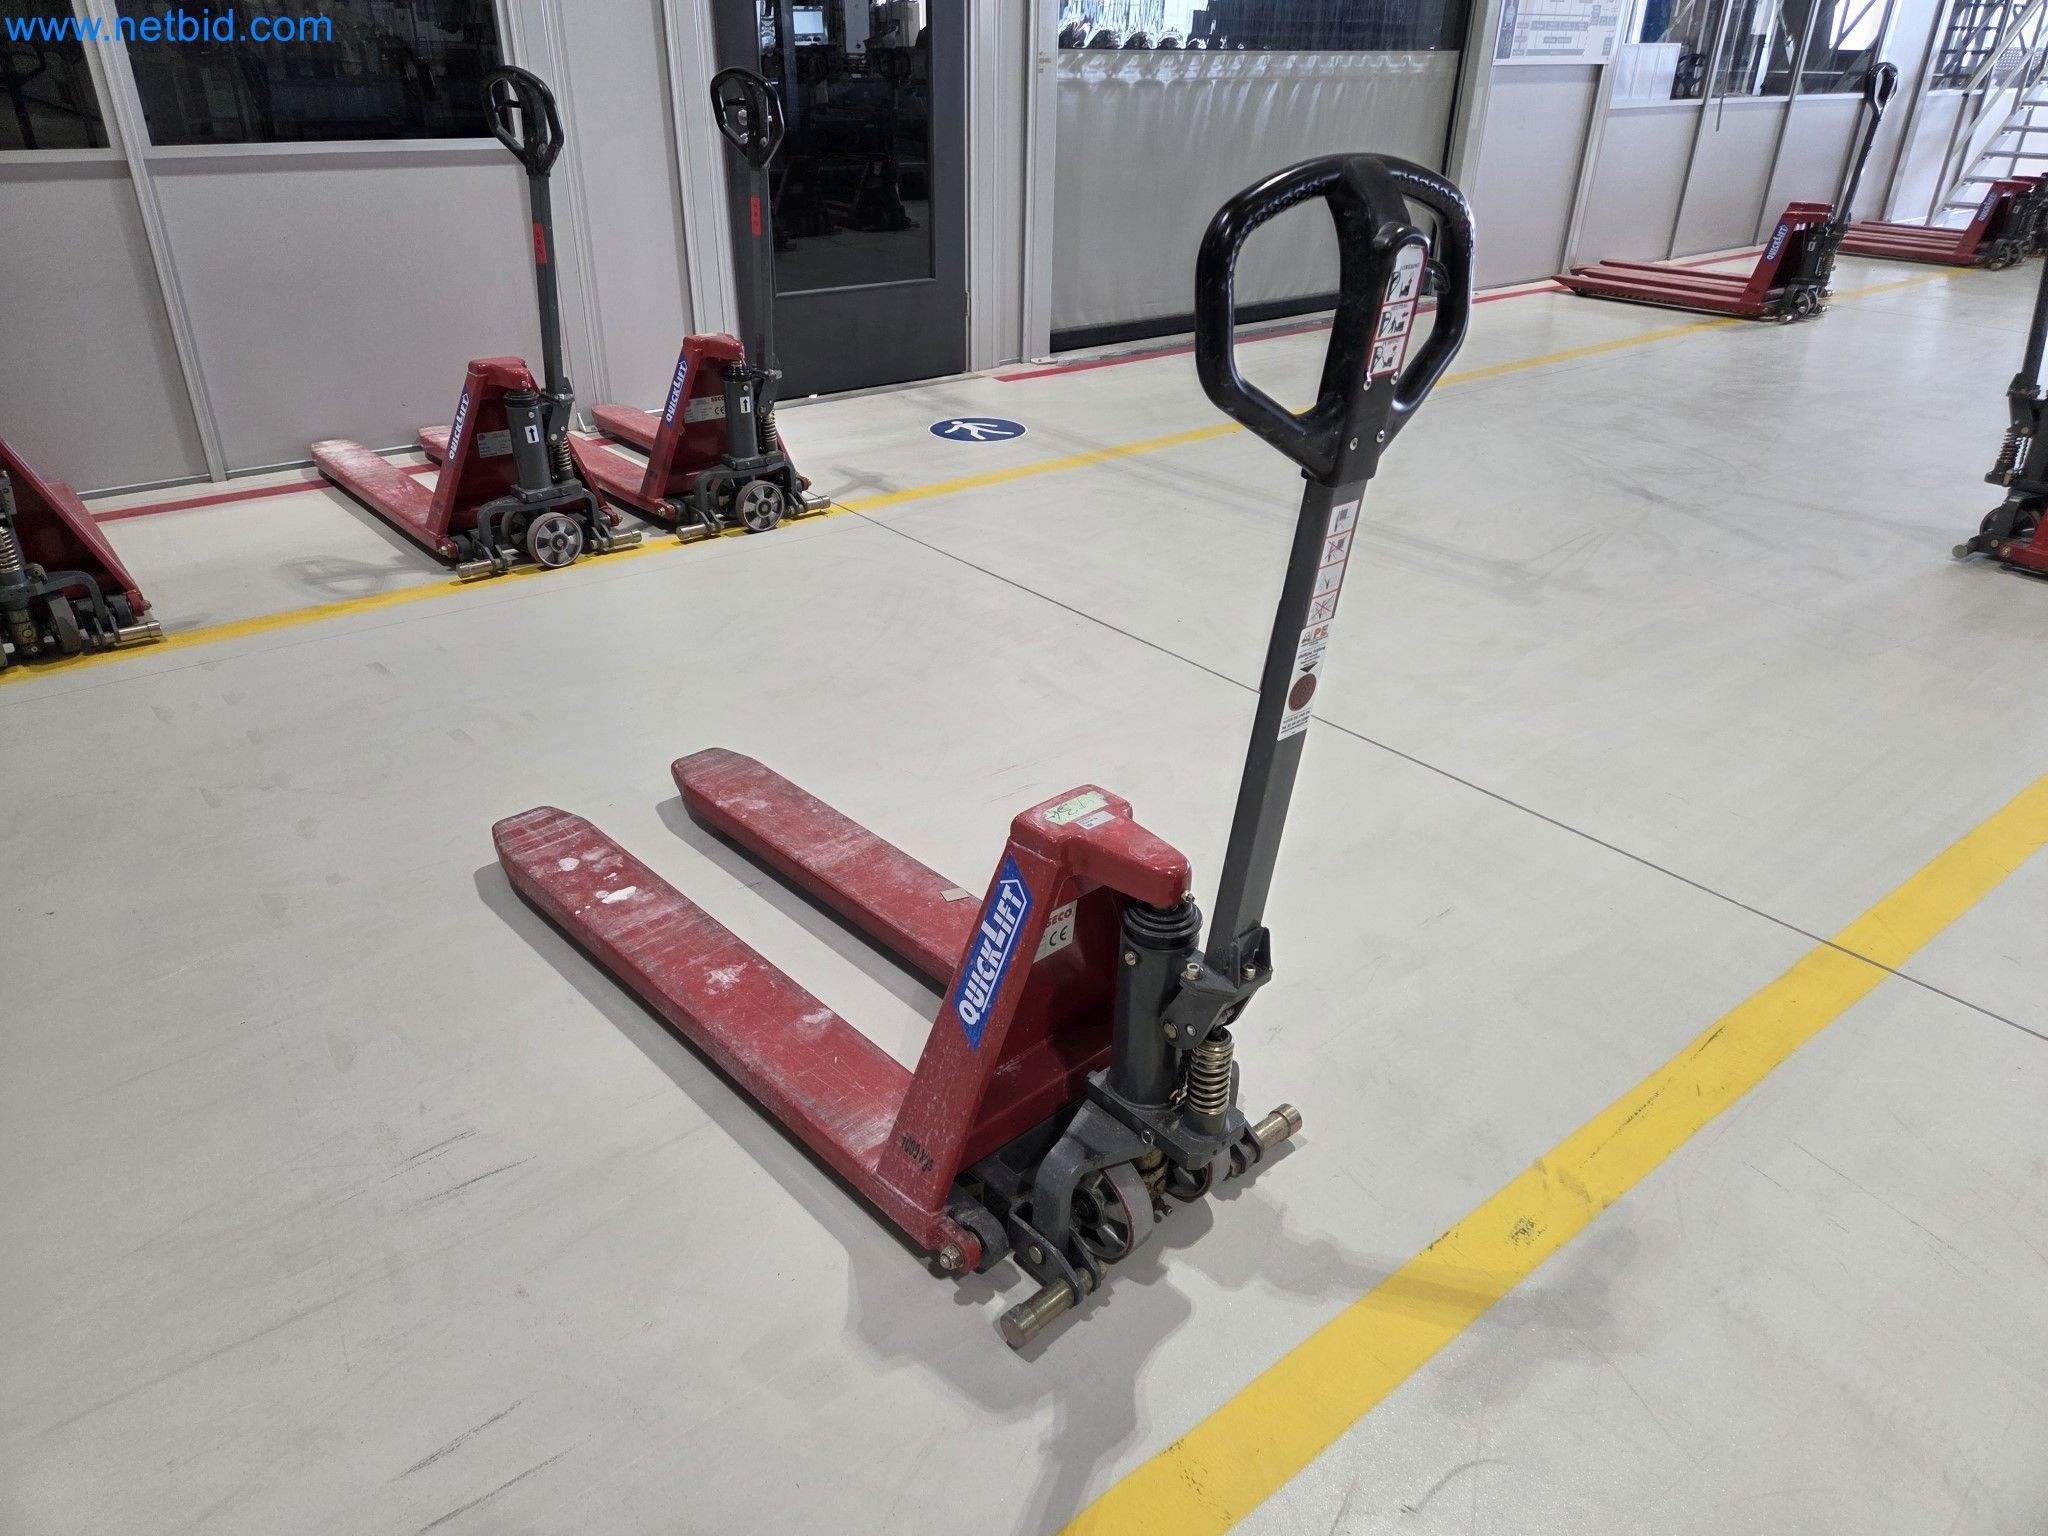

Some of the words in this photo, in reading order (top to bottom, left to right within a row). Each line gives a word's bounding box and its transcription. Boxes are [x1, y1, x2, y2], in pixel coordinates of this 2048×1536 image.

[666, 363, 687, 423] QUICKLIFT
[448, 396, 470, 460] QUICKLIFT
[958, 883, 1024, 1026] QUICKLIFT
